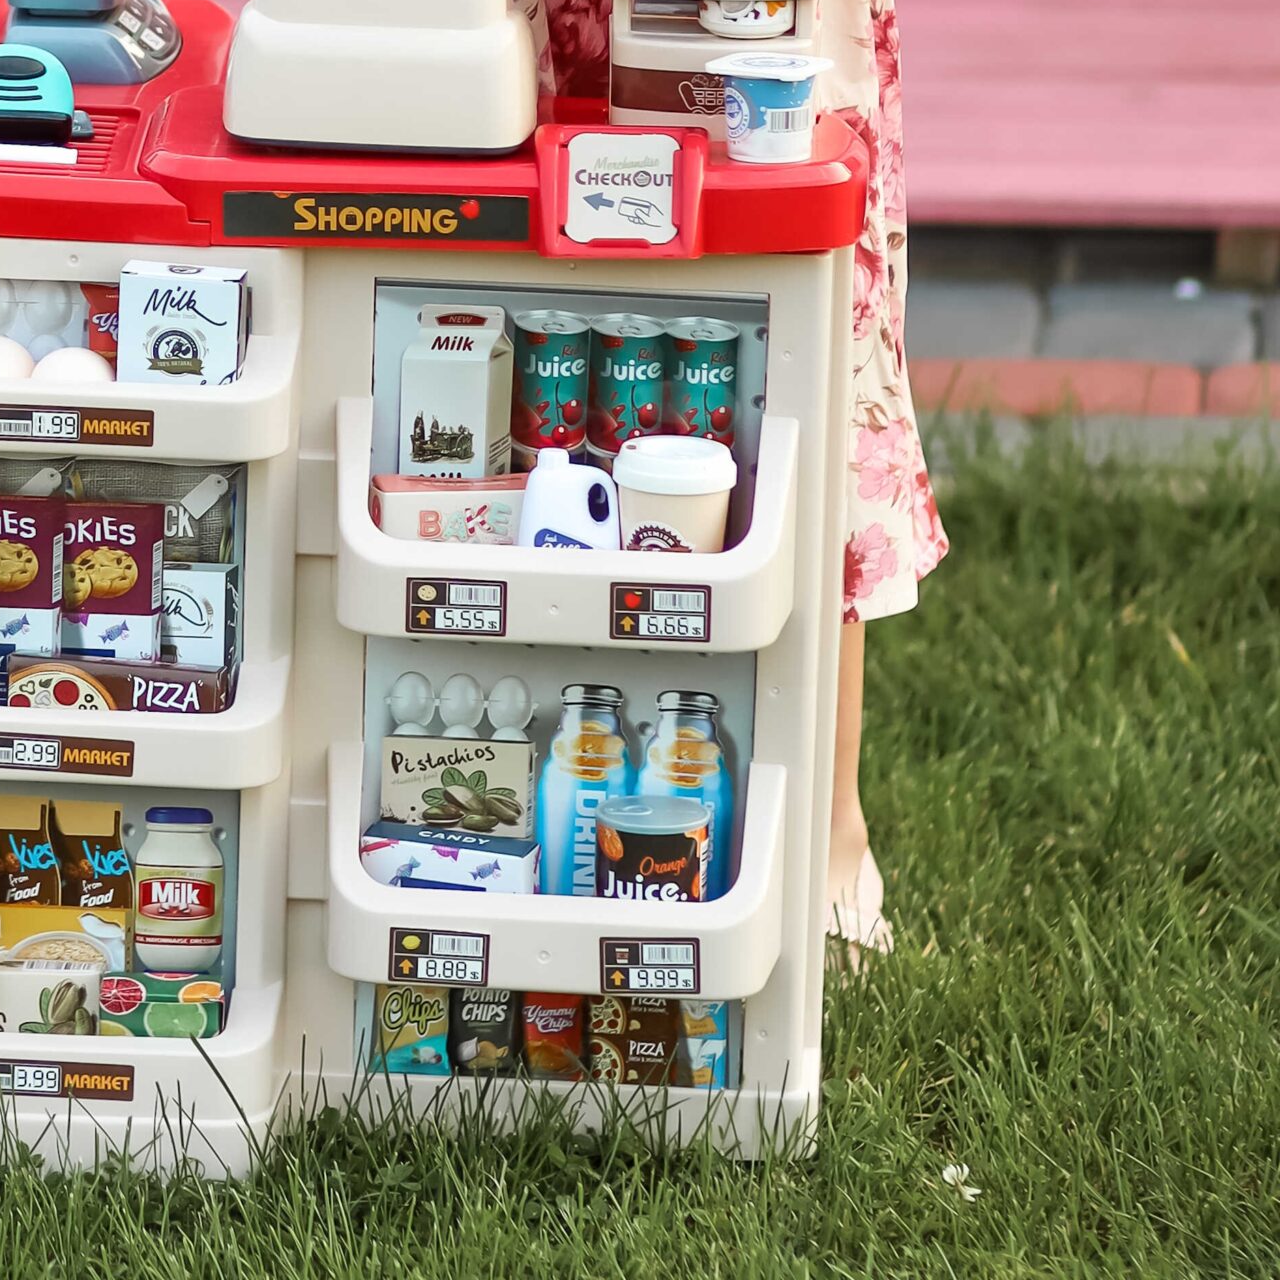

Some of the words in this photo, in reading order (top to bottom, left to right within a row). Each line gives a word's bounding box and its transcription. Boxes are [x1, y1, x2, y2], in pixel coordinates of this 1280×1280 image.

[593, 156, 660, 171] Merchandise
[575, 169, 673, 188] CHECKOUT
[293, 197, 458, 233] SHOPPING
[448, 315, 473, 324] NEW
[430, 335, 475, 352] Milk
[525, 353, 586, 378] Juice
[600, 356, 662, 381] Juice
[673, 360, 735, 385] Juice
[37, 415, 76, 434] 1.99
[83, 419, 151, 436] MARKET
[64, 516, 136, 545] OKIES
[418, 501, 512, 540] BAKE
[15, 742, 57, 763] 2.99
[63, 748, 131, 767] MARKET
[391, 746, 496, 774] Pistachios
[418, 830, 490, 845] CANDY
[572, 789, 606, 897] DRIN
[640, 856, 687, 876] Orange
[8, 873, 29, 887] from
[82, 880, 103, 893] from
[6, 882, 41, 902] Food
[80, 888, 114, 907] Food
[151, 881, 200, 905] Milk
[462, 988, 511, 1003] POTATO
[382, 986, 445, 1037] Chips
[461, 1003, 508, 1022] CHIPS
[524, 1005, 576, 1022] Yummy
[535, 1016, 573, 1033] Chips
[16, 1068, 57, 1089] 3.99
[64, 1073, 131, 1091] MARKET
